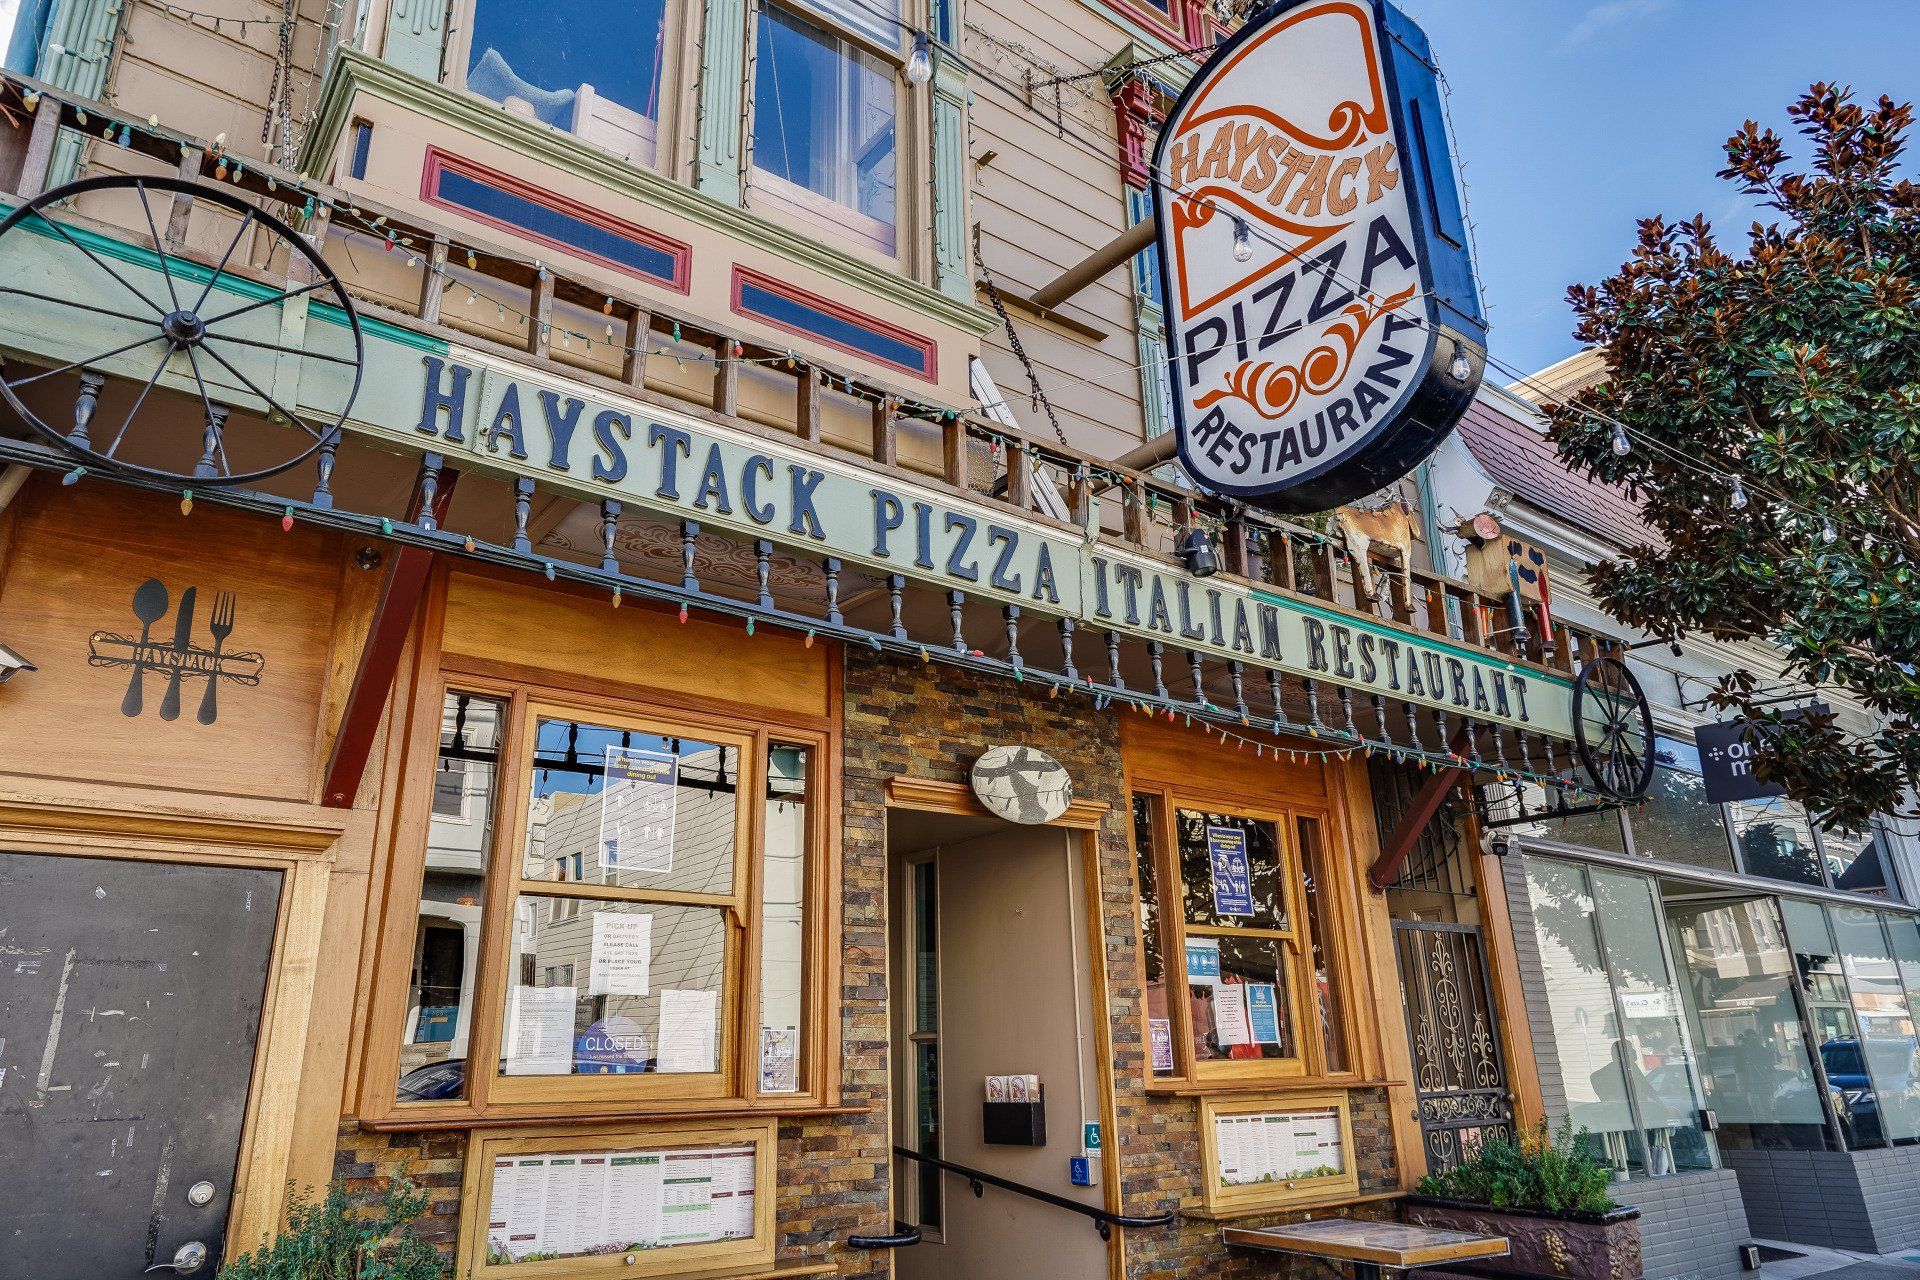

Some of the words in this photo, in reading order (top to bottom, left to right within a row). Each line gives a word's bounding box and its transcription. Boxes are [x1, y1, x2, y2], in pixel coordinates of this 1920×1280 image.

[1170, 120, 1398, 217] HAYSTACK
[1184, 215, 1417, 387] PIZZA
[1191, 314, 1423, 475] RESTAURANT
[416, 356, 826, 541] HAYSTACK
[870, 489, 1060, 602] PIZZA
[1091, 557, 1283, 661] ITALIAN
[1302, 615, 1529, 721] RESTAURANT
[133, 643, 223, 673] HAYSTACK
[627, 770, 646, 779] dining
[585, 1037, 643, 1051] CLOSED
